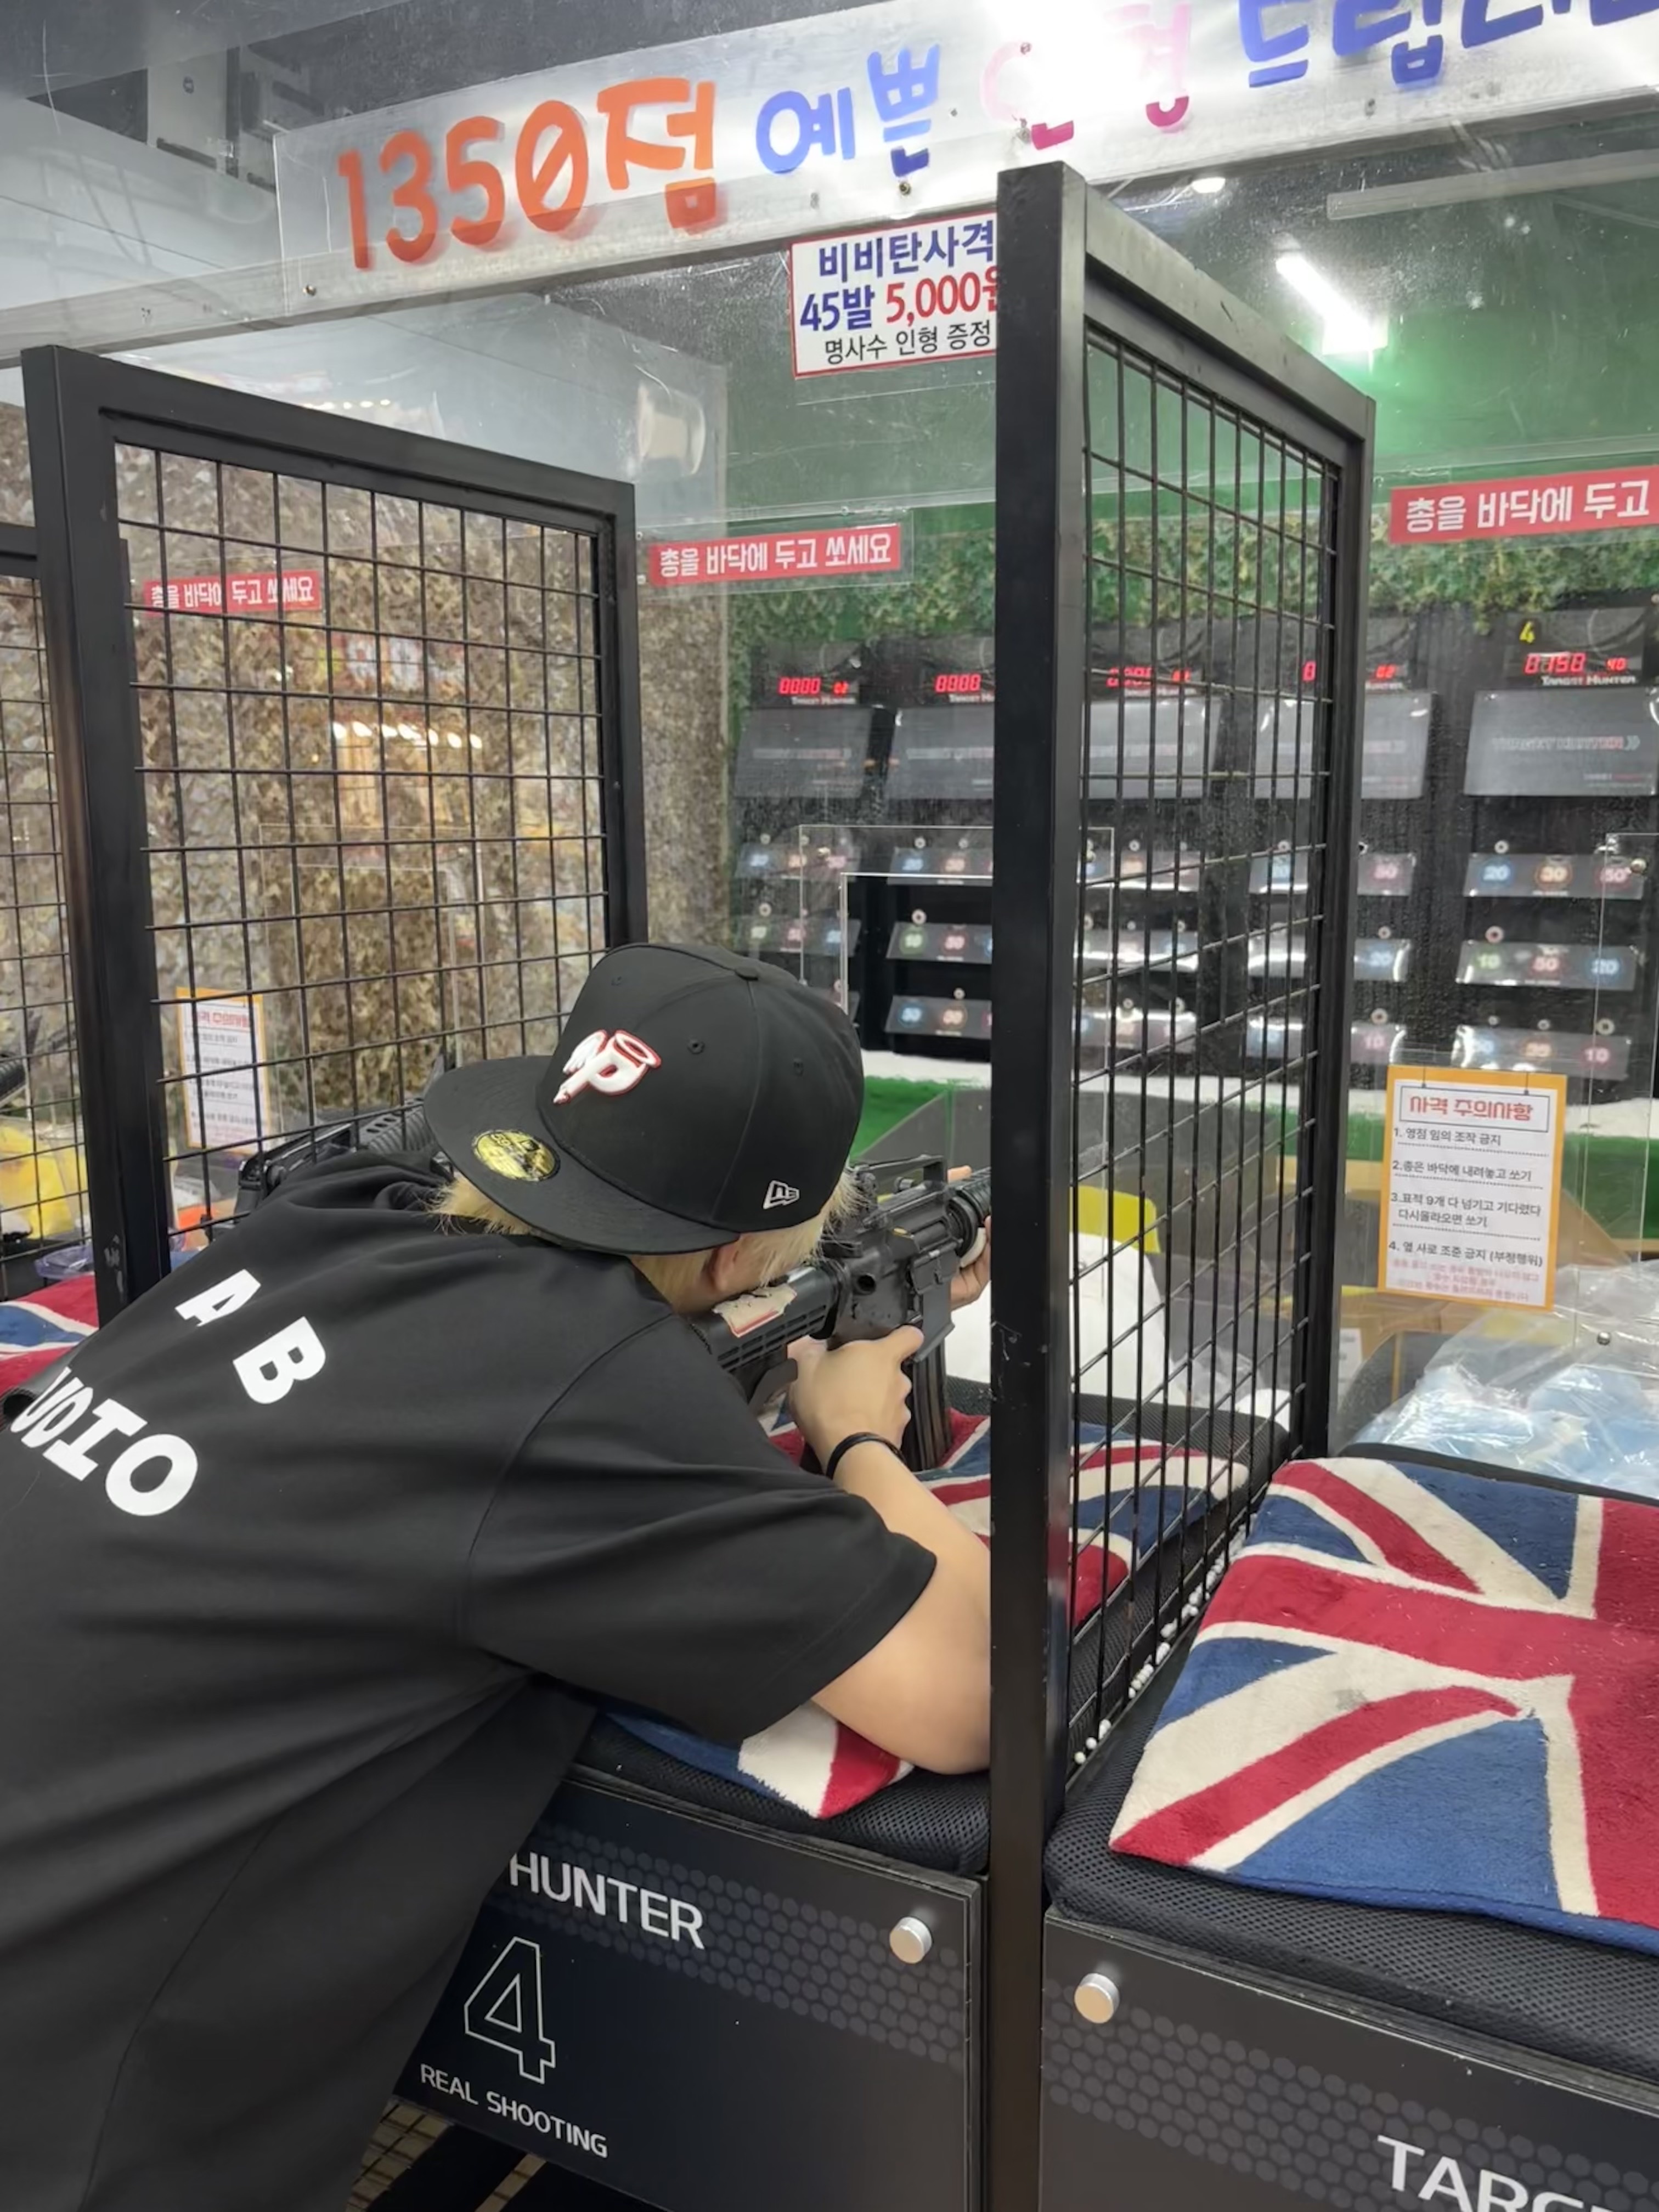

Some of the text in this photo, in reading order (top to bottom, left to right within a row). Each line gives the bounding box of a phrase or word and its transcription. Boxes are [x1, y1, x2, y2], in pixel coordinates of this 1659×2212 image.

[338, 77, 719, 270] 1350점
[757, 44, 940, 177] 예쁜
[819, 219, 994, 283] 비비탄사격
[800, 285, 875, 331] 45발
[825, 320, 990, 365] 명사수 인형 증정
[1406, 480, 1650, 533] 총을 바닥에 두고
[659, 533, 891, 578] 총을 바닥에 두고 쏘세요
[231, 580, 263, 605] 두고
[1519, 621, 1535, 644] 4
[1409, 1096, 1533, 1122] 사격 주의사항
[1479, 1133, 1502, 1146] 금지
[1427, 1162, 1460, 1176] 바닥에
[1426, 1195, 1445, 1207] 9개
[1448, 1197, 1459, 1209] 다
[1462, 1199, 1494, 1211] 넘기고
[1464, 1248, 1487, 1261] 금지
[510, 1852, 705, 1950] HUNTER
[464, 1936, 556, 2084] 4
[420, 2063, 608, 2158] REAL SHOOTING
[1378, 2134, 1659, 2212] TAR
